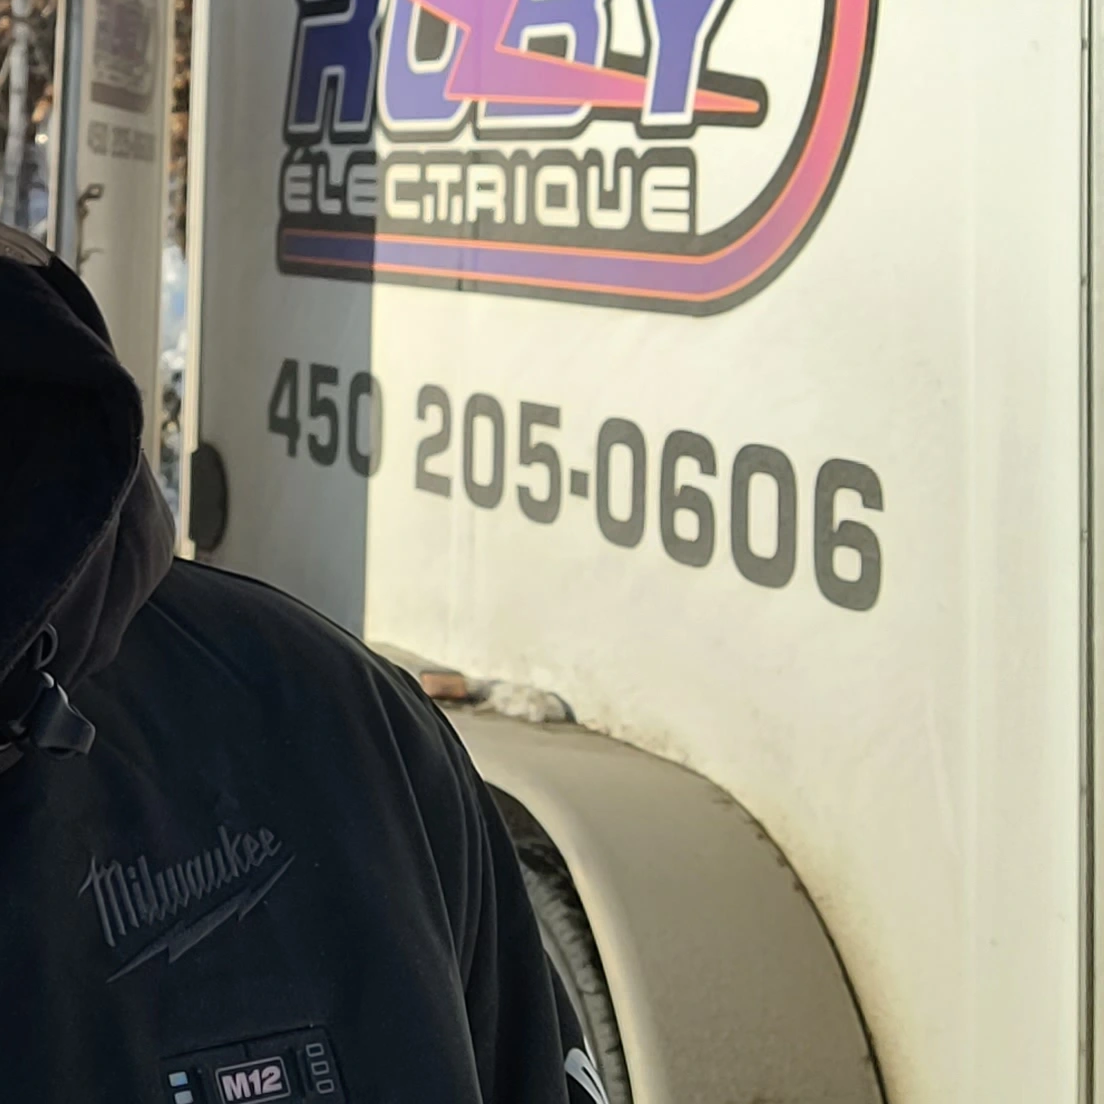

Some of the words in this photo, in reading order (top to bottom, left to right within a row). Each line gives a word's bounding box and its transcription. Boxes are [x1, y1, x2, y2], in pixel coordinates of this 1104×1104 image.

[283, 148, 692, 233] ÉLECTRIQUE
[267, 359, 383, 478] 450
[414, 384, 885, 613] 205-0606
[79, 825, 282, 947] Milwaukee
[221, 1066, 283, 1101] M12
